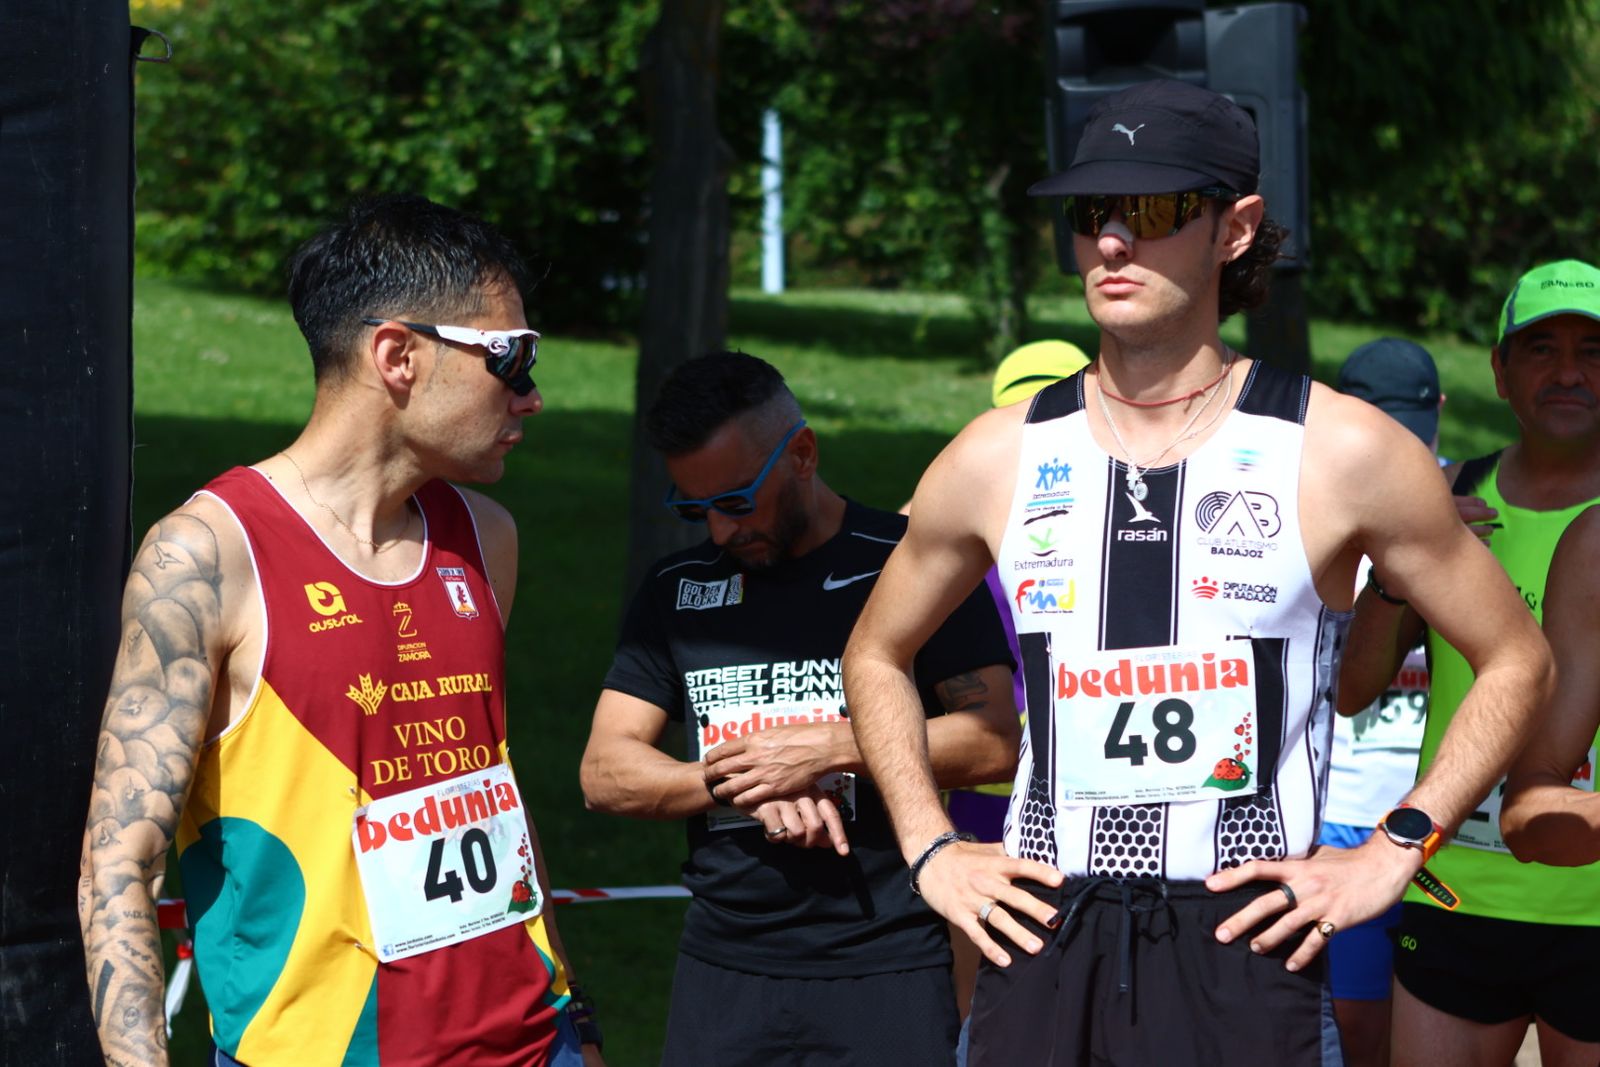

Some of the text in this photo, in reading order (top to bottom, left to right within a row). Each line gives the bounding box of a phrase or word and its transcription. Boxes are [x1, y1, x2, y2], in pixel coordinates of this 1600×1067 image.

[1117, 527, 1167, 542] rasán
[1196, 537, 1278, 552] CLUB ATLETISMO
[1210, 546, 1264, 559] BADAJOZ
[1014, 558, 1074, 571] Extremadura
[683, 583, 722, 596] GOLDEN
[1223, 580, 1278, 595] DIPUTACIÓN
[1233, 590, 1278, 604] BADAJOZ
[681, 593, 719, 607] BLOCKS
[308, 613, 364, 633] austral
[397, 651, 432, 663] ZAMORA
[685, 663, 768, 688] STREET
[1057, 652, 1249, 700] bedunia
[390, 673, 492, 703] CAJA RURAL
[688, 680, 768, 703] STREET
[393, 715, 466, 749] VINO
[1103, 698, 1197, 767] 48
[370, 745, 491, 786] DE TORO
[355, 778, 518, 854] bedunia
[423, 827, 498, 904] 40
